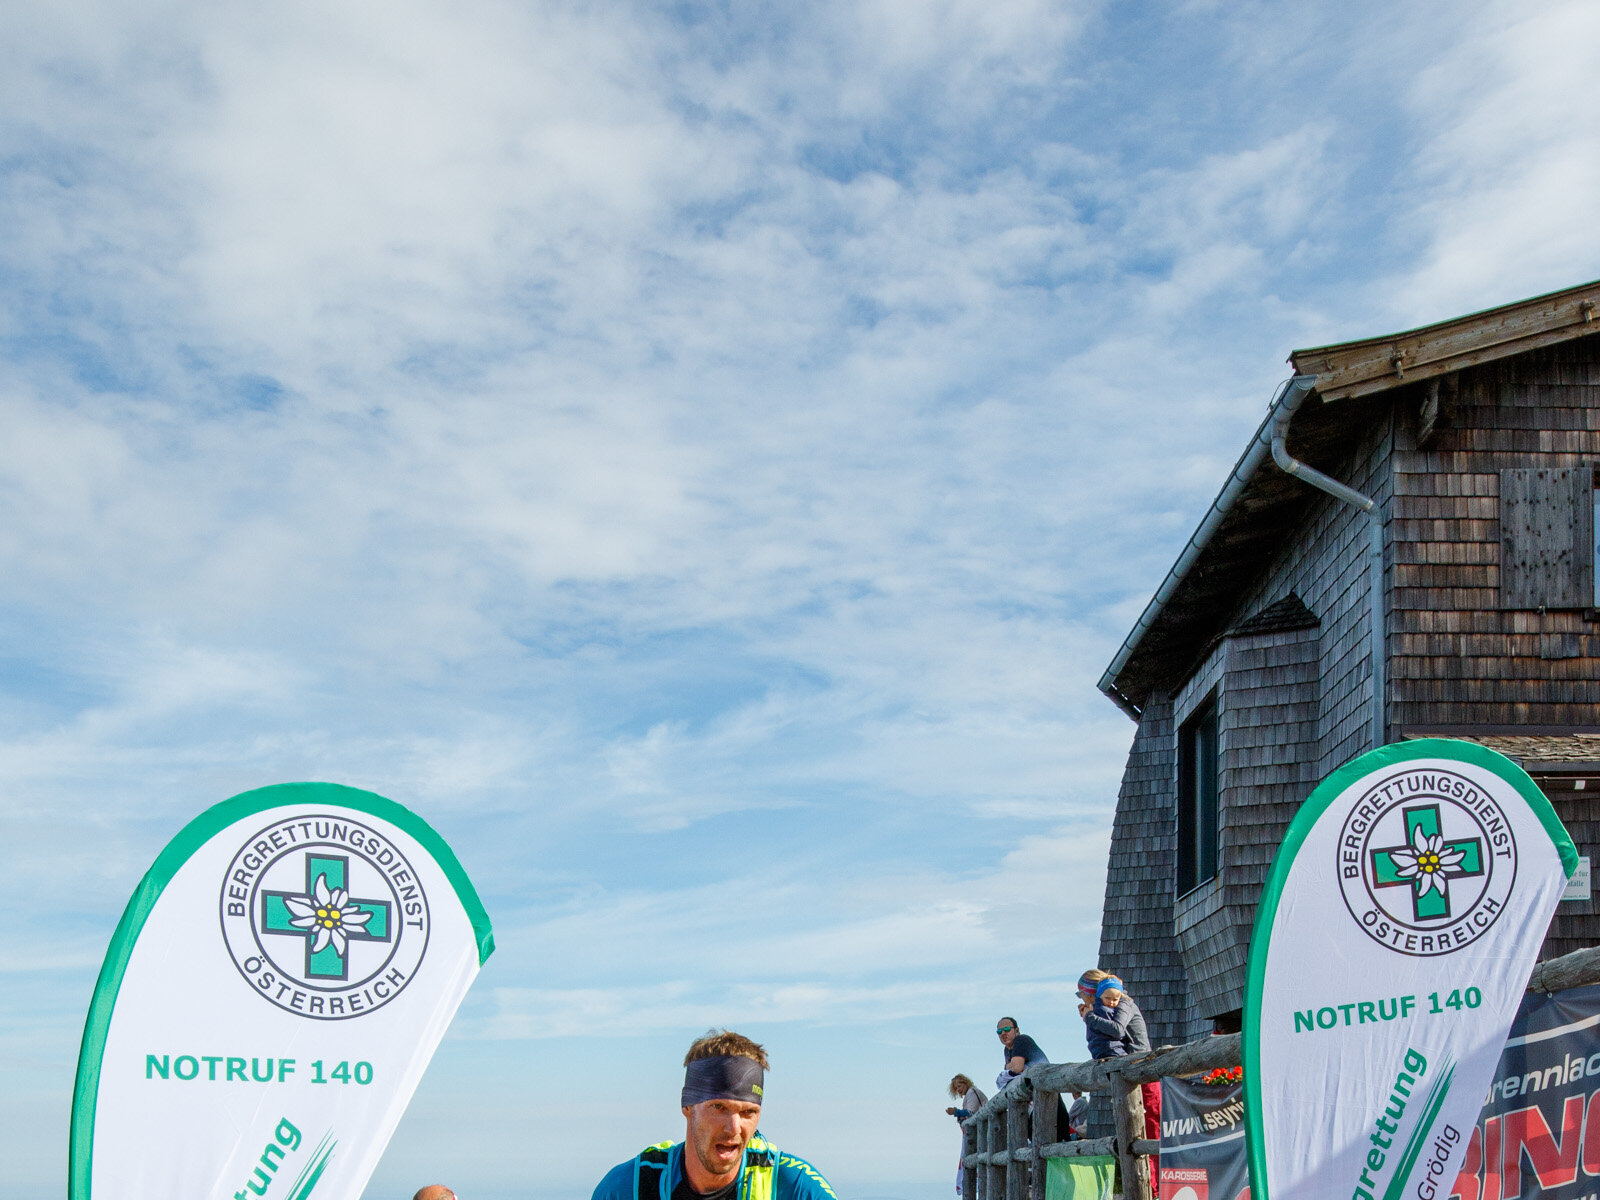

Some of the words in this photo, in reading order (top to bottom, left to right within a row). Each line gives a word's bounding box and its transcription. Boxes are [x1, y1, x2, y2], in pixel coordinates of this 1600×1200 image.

[1344, 775, 1512, 879] BERGRETTUNGSDIENST
[228, 821, 424, 931] BERGRETTUNGSDIENST
[1362, 897, 1501, 952] ÖSTERREICH
[244, 955, 406, 1015] ÖSTERREICH
[1294, 995, 1416, 1034] NOTRUF
[1428, 986, 1482, 1015] 140
[146, 1054, 296, 1083] NOTRUF
[310, 1060, 374, 1085] 140
[1160, 1170, 1207, 1181] KAROSSERIE
